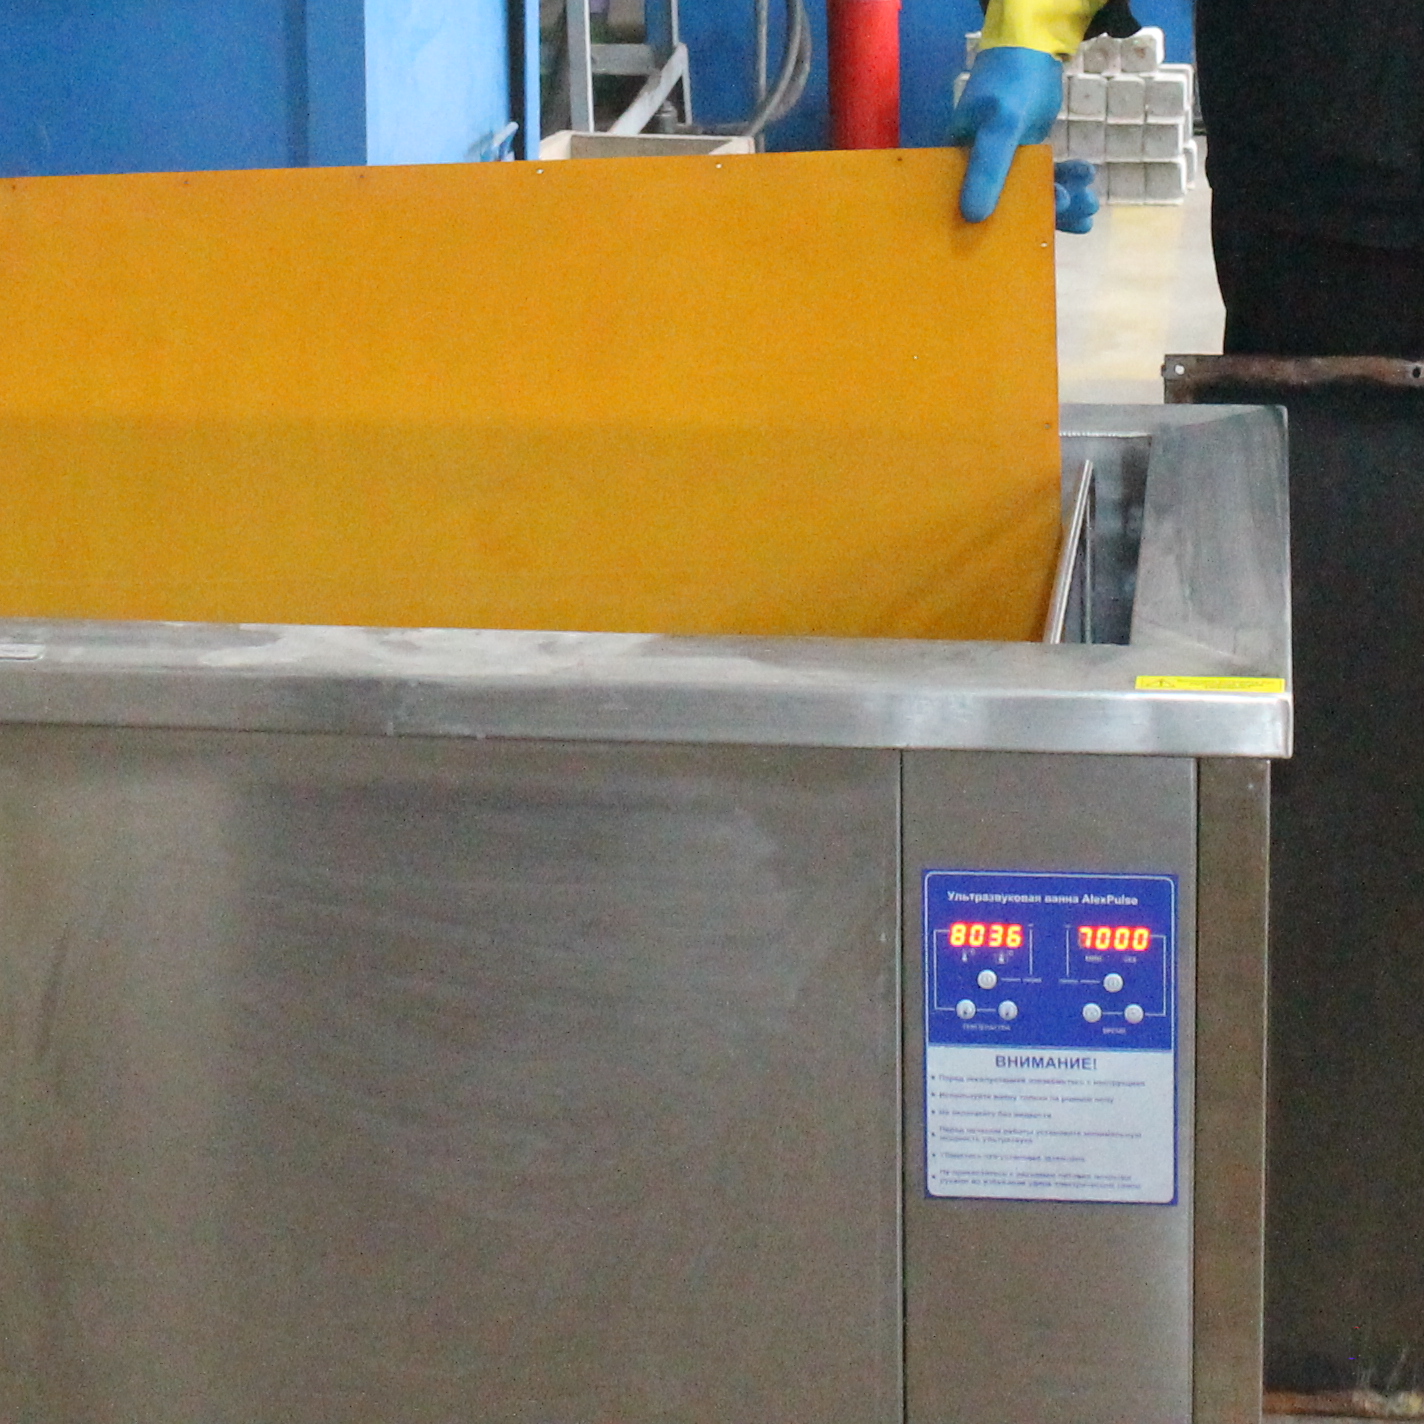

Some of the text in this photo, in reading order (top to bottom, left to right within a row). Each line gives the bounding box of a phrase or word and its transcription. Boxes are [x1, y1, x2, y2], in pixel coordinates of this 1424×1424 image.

[947, 891, 1139, 906] Ультразвуковая ванна AlexPulse
[1079, 926, 1151, 951] 7000
[995, 1055, 1098, 1070] ВНИМАНИЕ!
